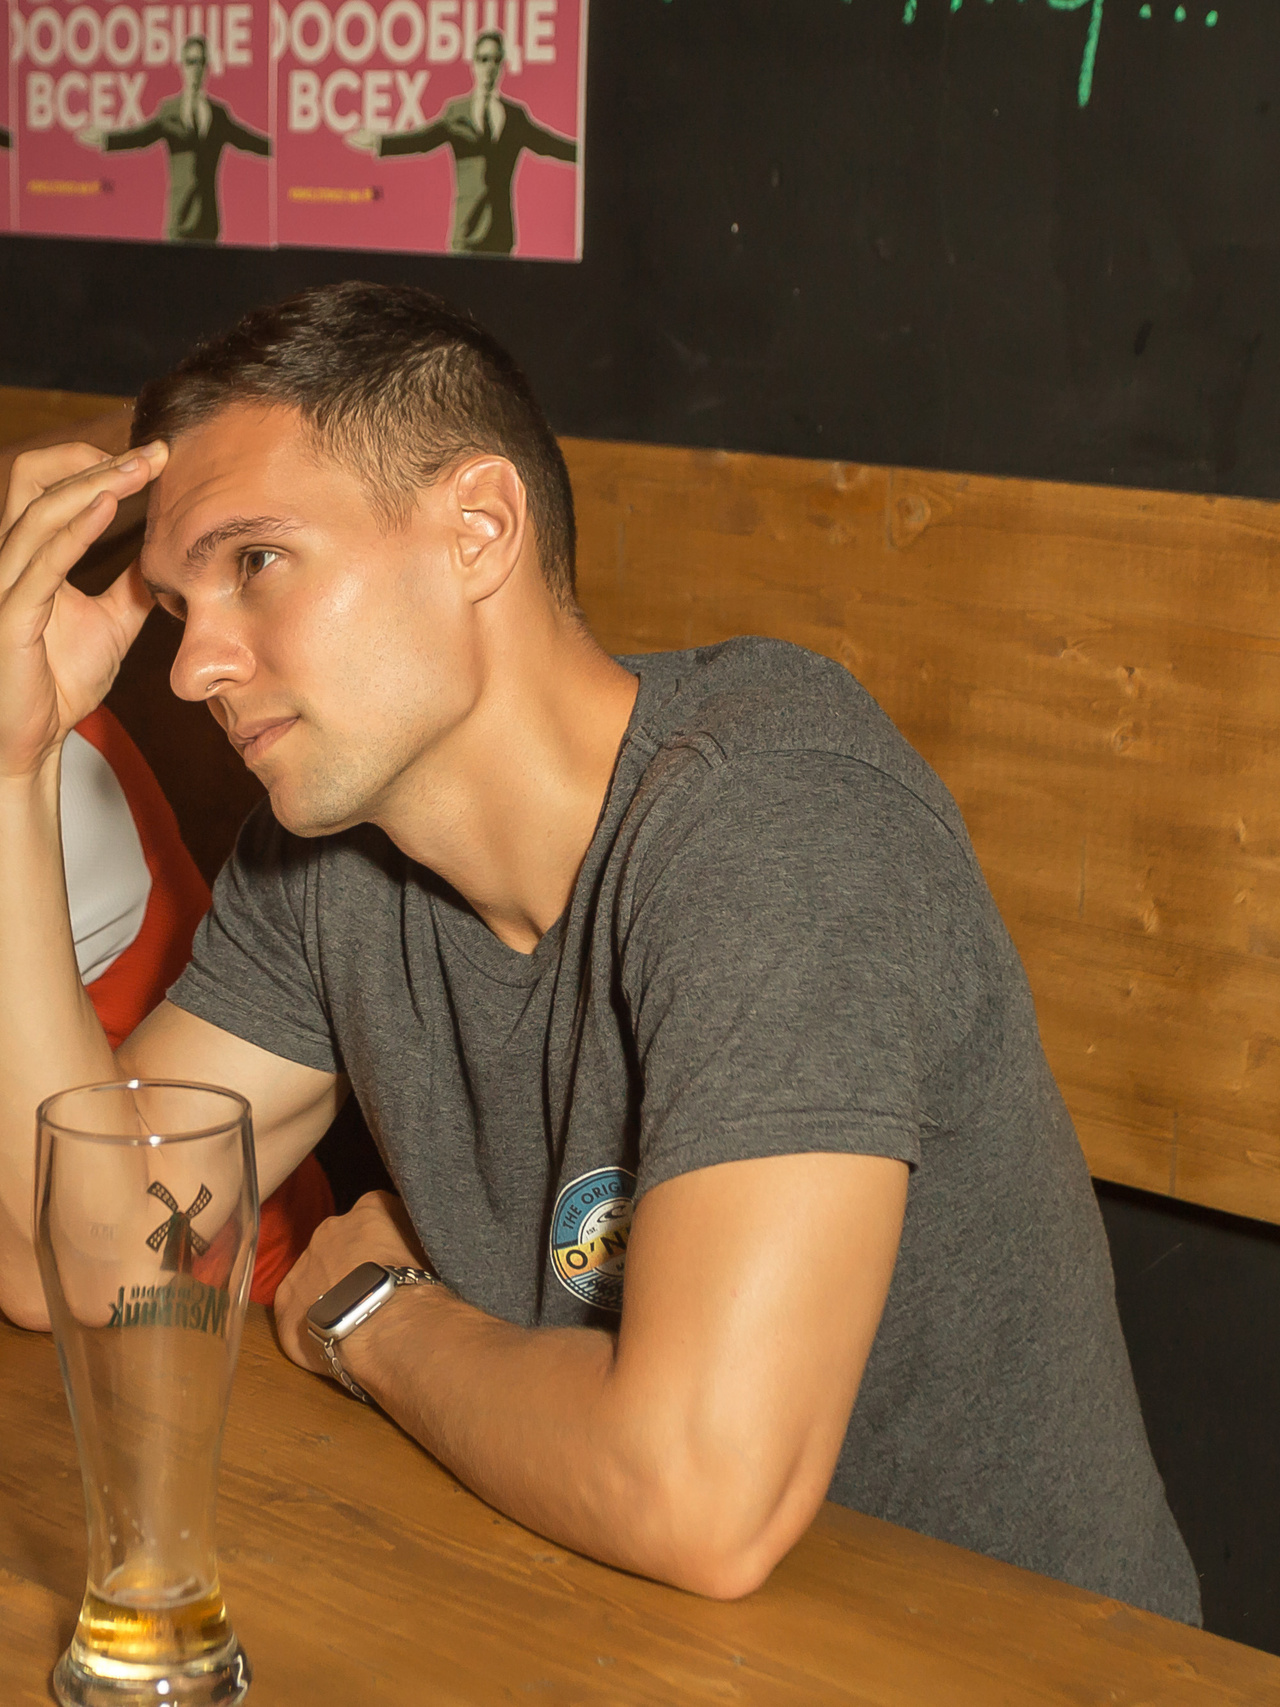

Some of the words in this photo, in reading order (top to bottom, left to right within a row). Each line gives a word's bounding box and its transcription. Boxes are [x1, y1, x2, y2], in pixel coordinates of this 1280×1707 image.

[26, 71, 148, 130] ВСЕХ
[288, 69, 430, 132] ВСЕХ
[563, 1204, 583, 1230] THE
